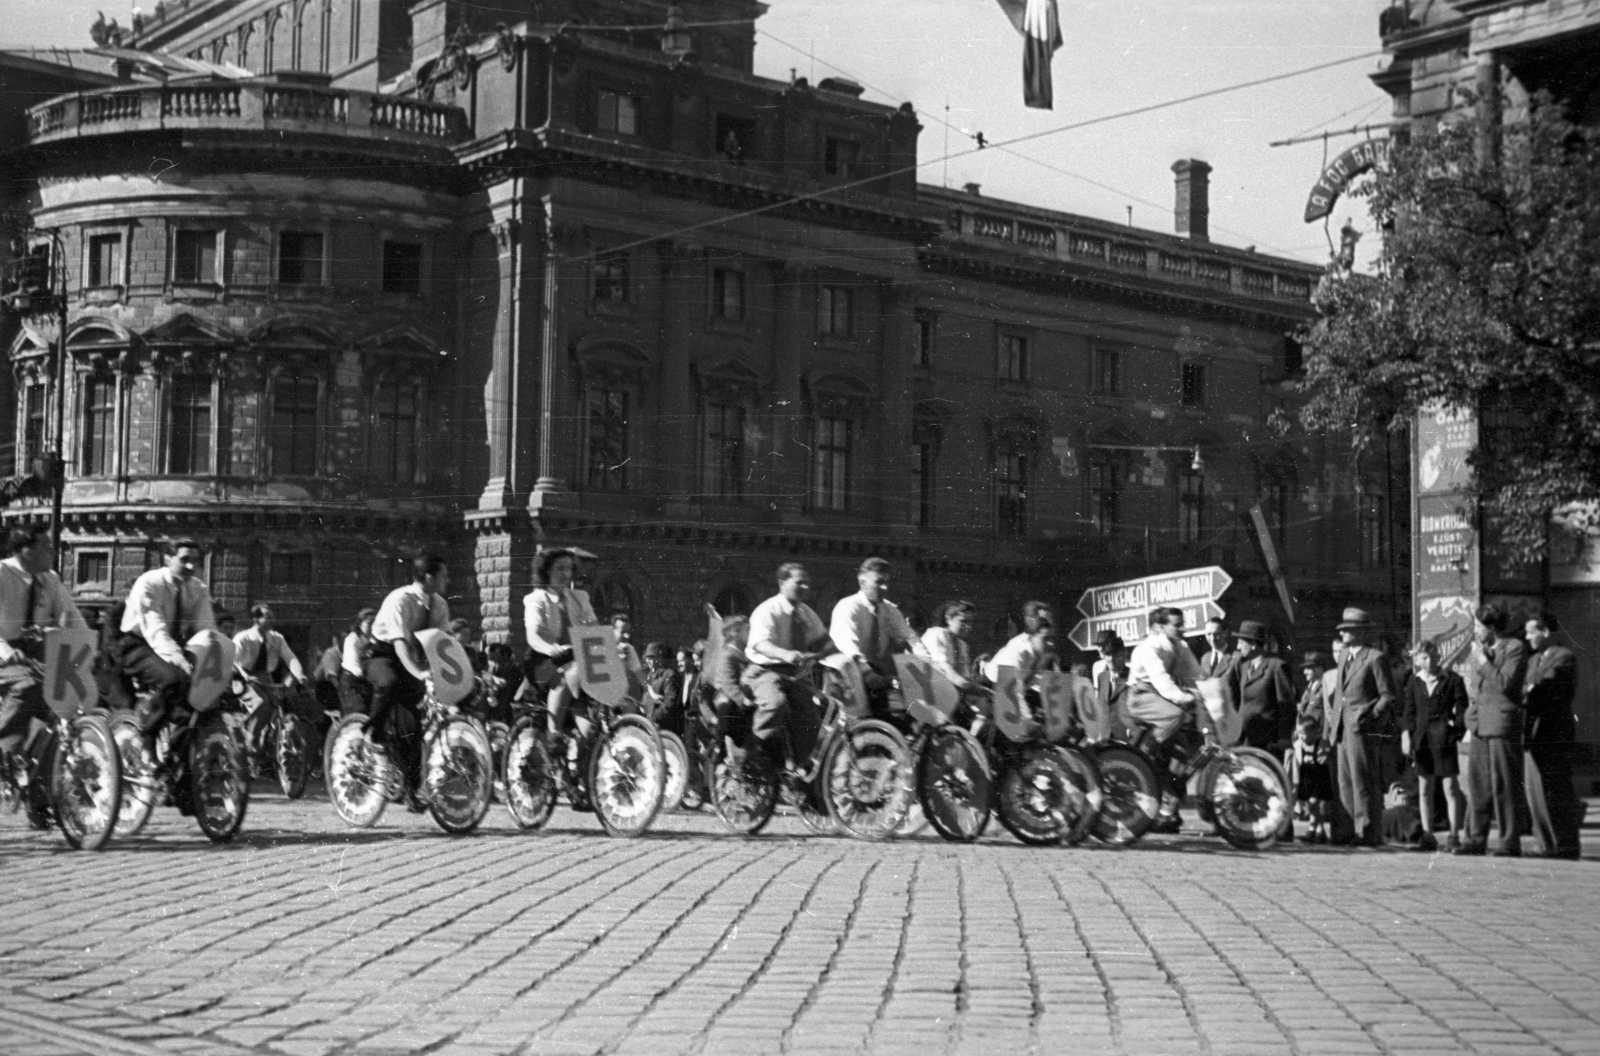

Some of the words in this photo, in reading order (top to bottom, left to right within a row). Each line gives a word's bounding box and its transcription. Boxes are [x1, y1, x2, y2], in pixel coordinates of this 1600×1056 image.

[1097, 584, 1145, 611] КЕЧКЕМЕД
[52, 643, 92, 701] K
[435, 637, 462, 685] S
[581, 636, 611, 684] E
[904, 661, 936, 706] Y
